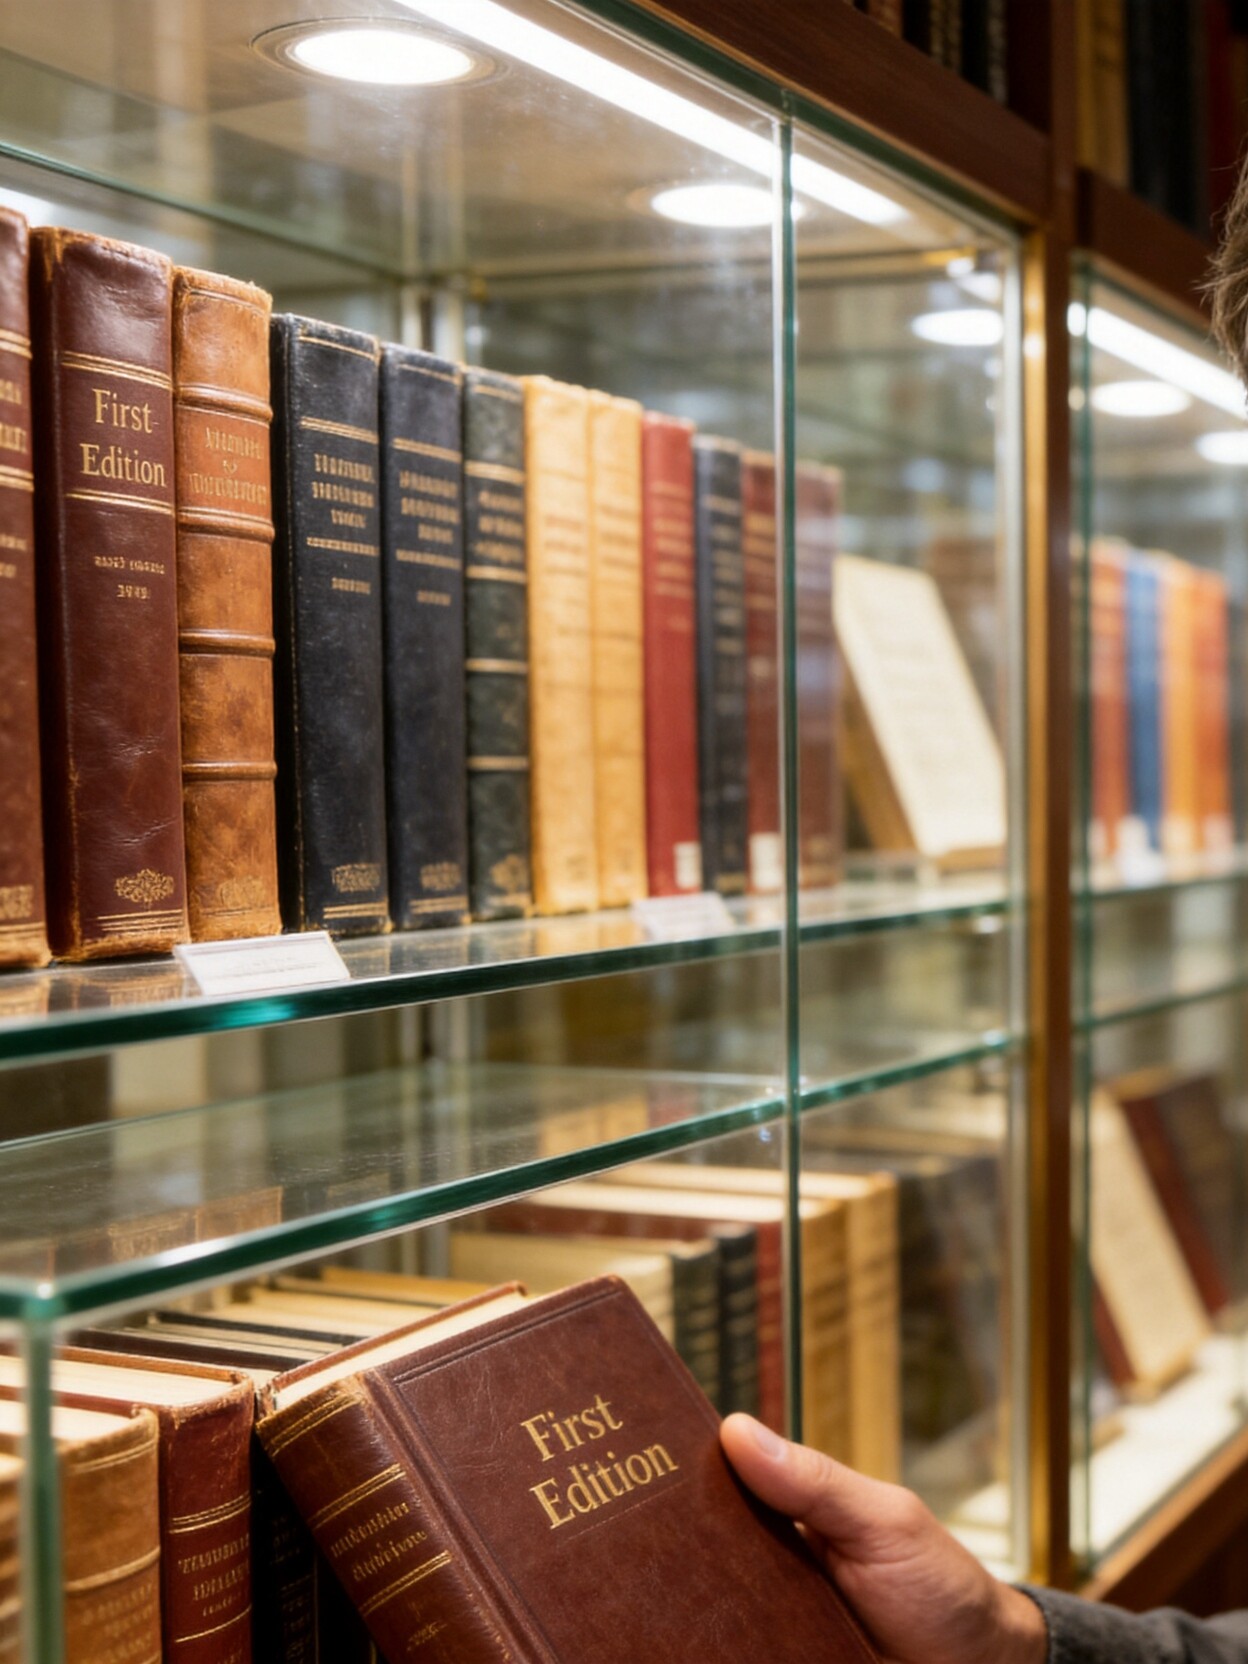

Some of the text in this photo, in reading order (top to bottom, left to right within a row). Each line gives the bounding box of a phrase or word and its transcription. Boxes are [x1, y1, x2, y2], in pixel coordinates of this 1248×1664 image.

[92, 388, 153, 433] First
[79, 443, 167, 488] Edition
[520, 1394, 624, 1462] First
[529, 1443, 679, 1530] Edition
